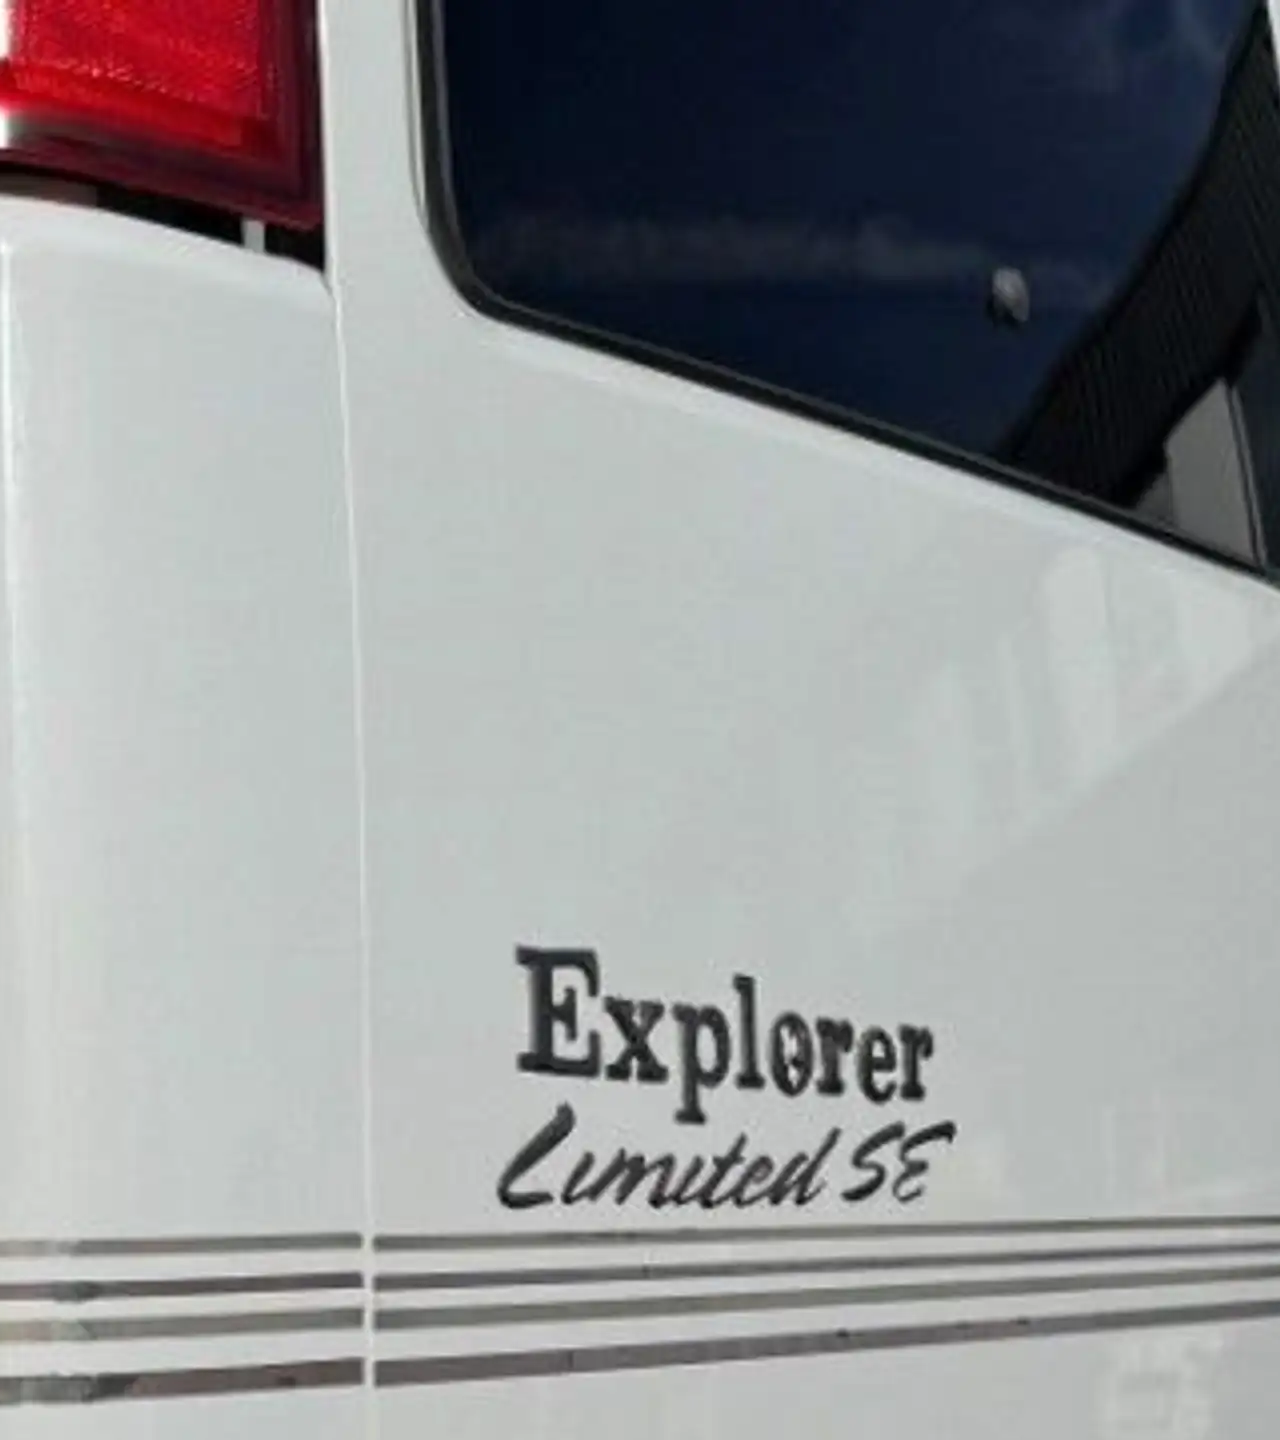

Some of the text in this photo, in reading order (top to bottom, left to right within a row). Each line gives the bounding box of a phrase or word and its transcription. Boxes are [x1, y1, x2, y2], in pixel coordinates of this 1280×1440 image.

[515, 943, 935, 1125] Explorer
[495, 1100, 958, 1210] Limited SE
